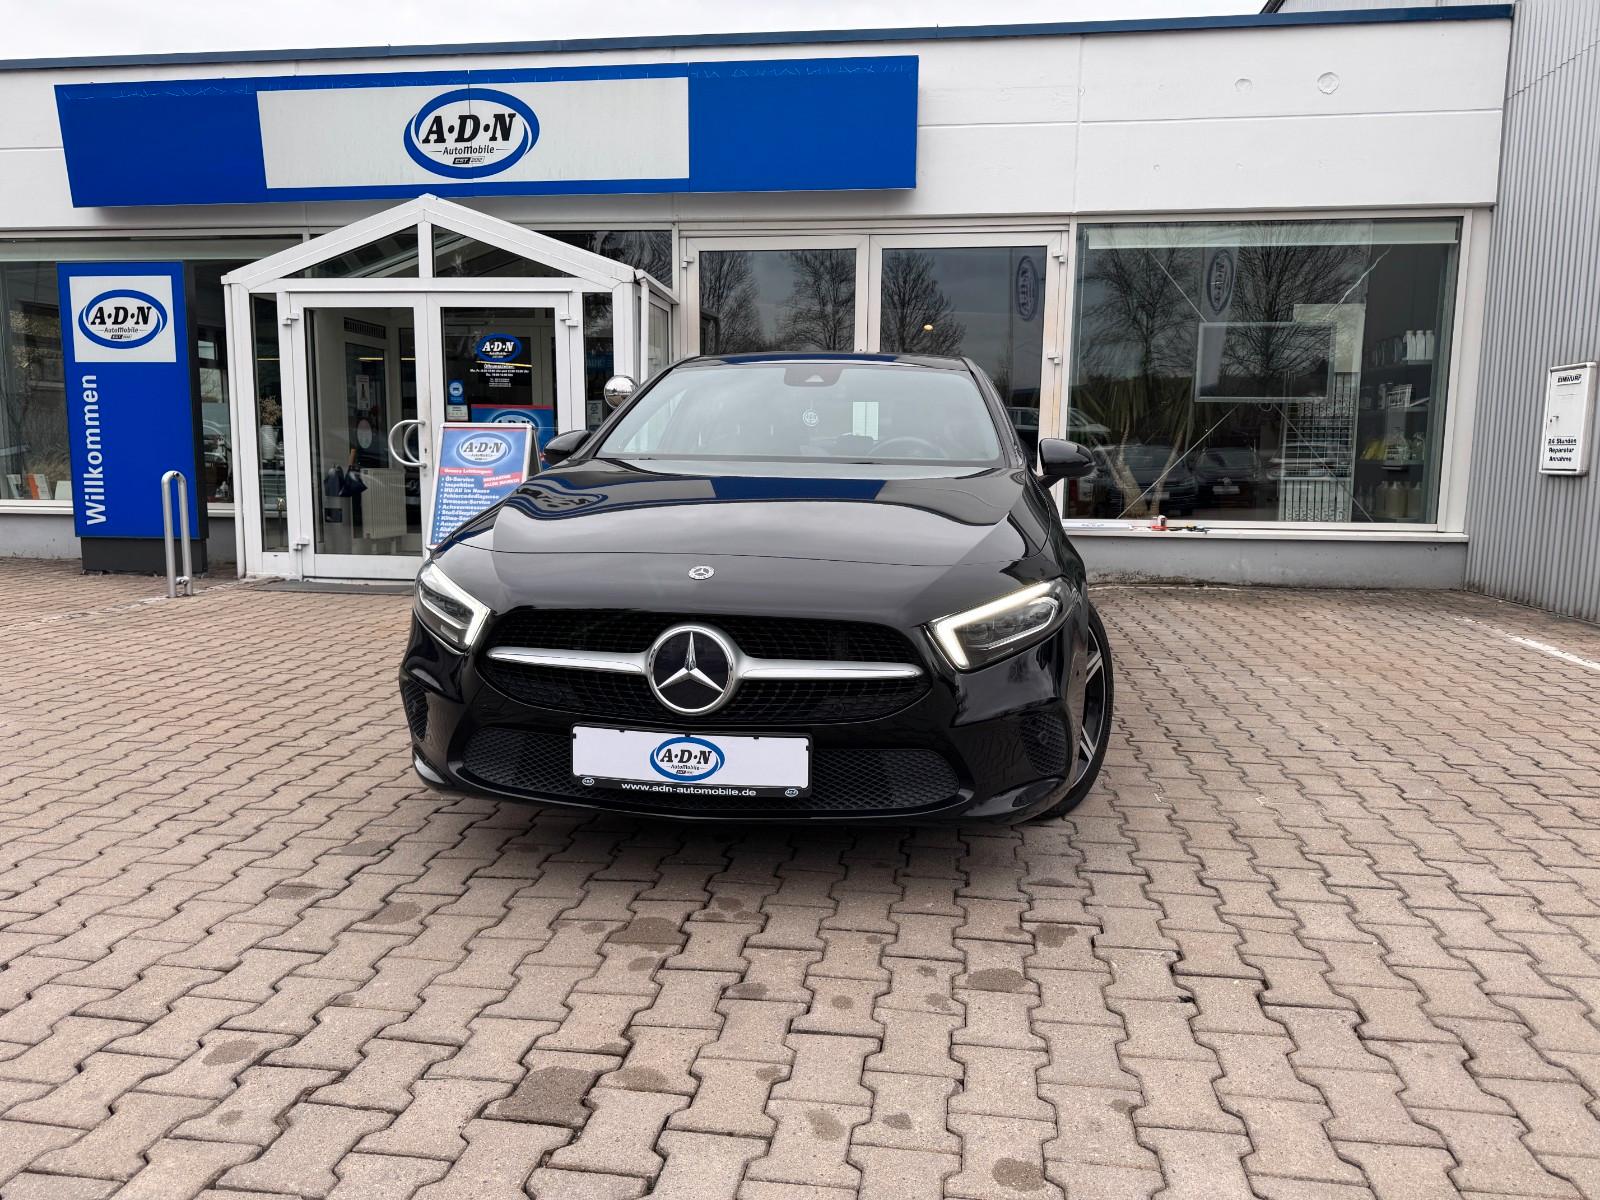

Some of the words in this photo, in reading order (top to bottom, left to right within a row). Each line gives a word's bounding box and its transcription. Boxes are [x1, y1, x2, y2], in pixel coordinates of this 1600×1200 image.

[442, 144, 495, 156] AutoMobile
[103, 326, 139, 334] AutoMobile
[81, 374, 107, 526] Willkommen
[621, 782, 757, 797] www.adn-automobile.de
